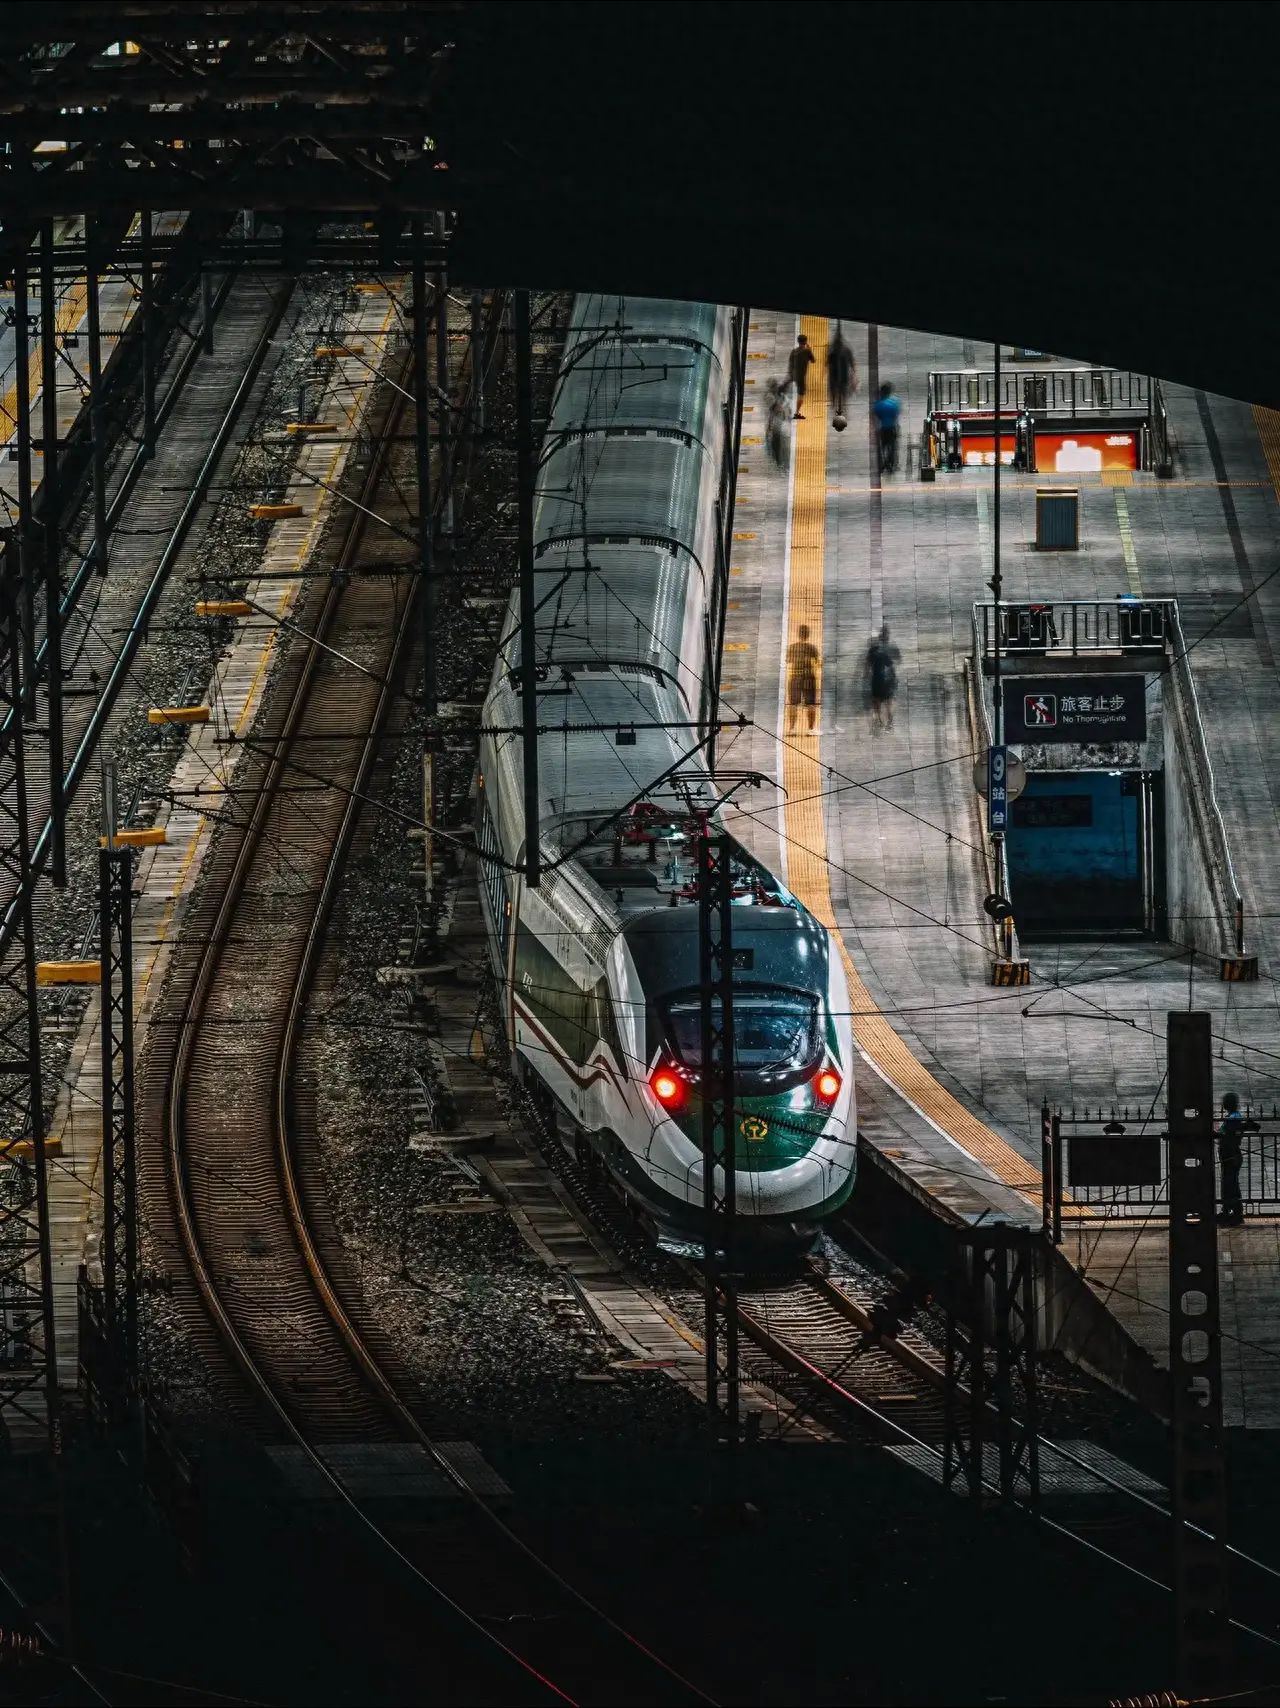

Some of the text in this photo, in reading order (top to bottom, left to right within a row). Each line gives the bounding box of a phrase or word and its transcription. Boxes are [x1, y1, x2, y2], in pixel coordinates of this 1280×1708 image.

[1061, 695, 1125, 711] 旅客止步
[1062, 715, 1074, 723] No
[992, 754, 1005, 825] 9站台
